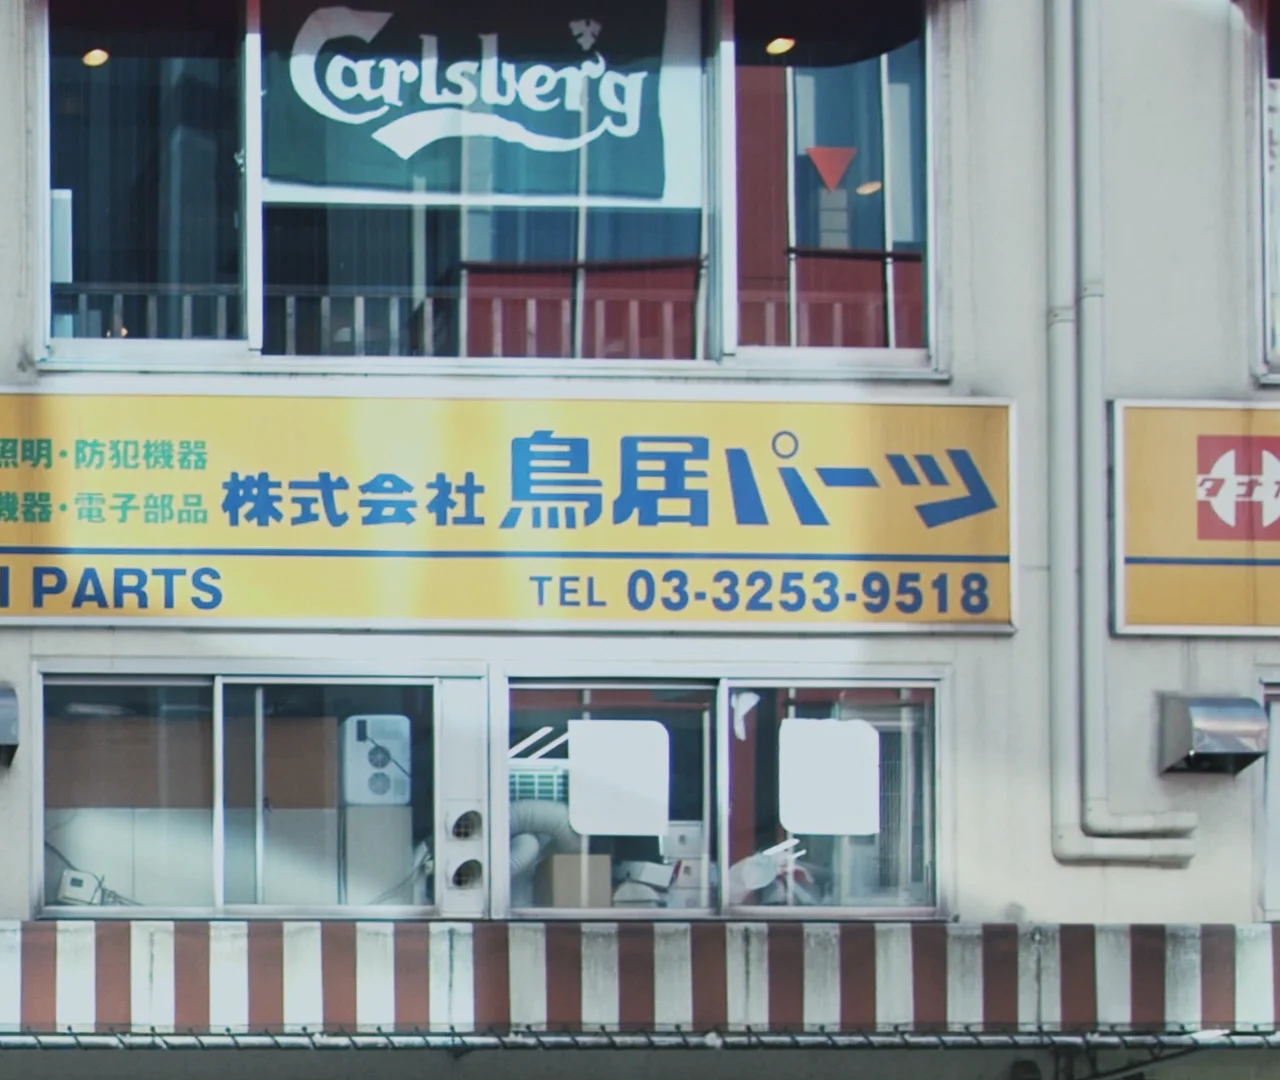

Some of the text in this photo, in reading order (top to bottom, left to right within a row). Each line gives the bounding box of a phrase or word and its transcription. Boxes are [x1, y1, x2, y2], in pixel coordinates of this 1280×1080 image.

[290, 7, 648, 160] Carlsberg
[222, 430, 997, 530] 株式会社 鳥居パーツ
[34, 567, 224, 611] PARTS
[529, 569, 990, 616] TEL 03-3253-9518
